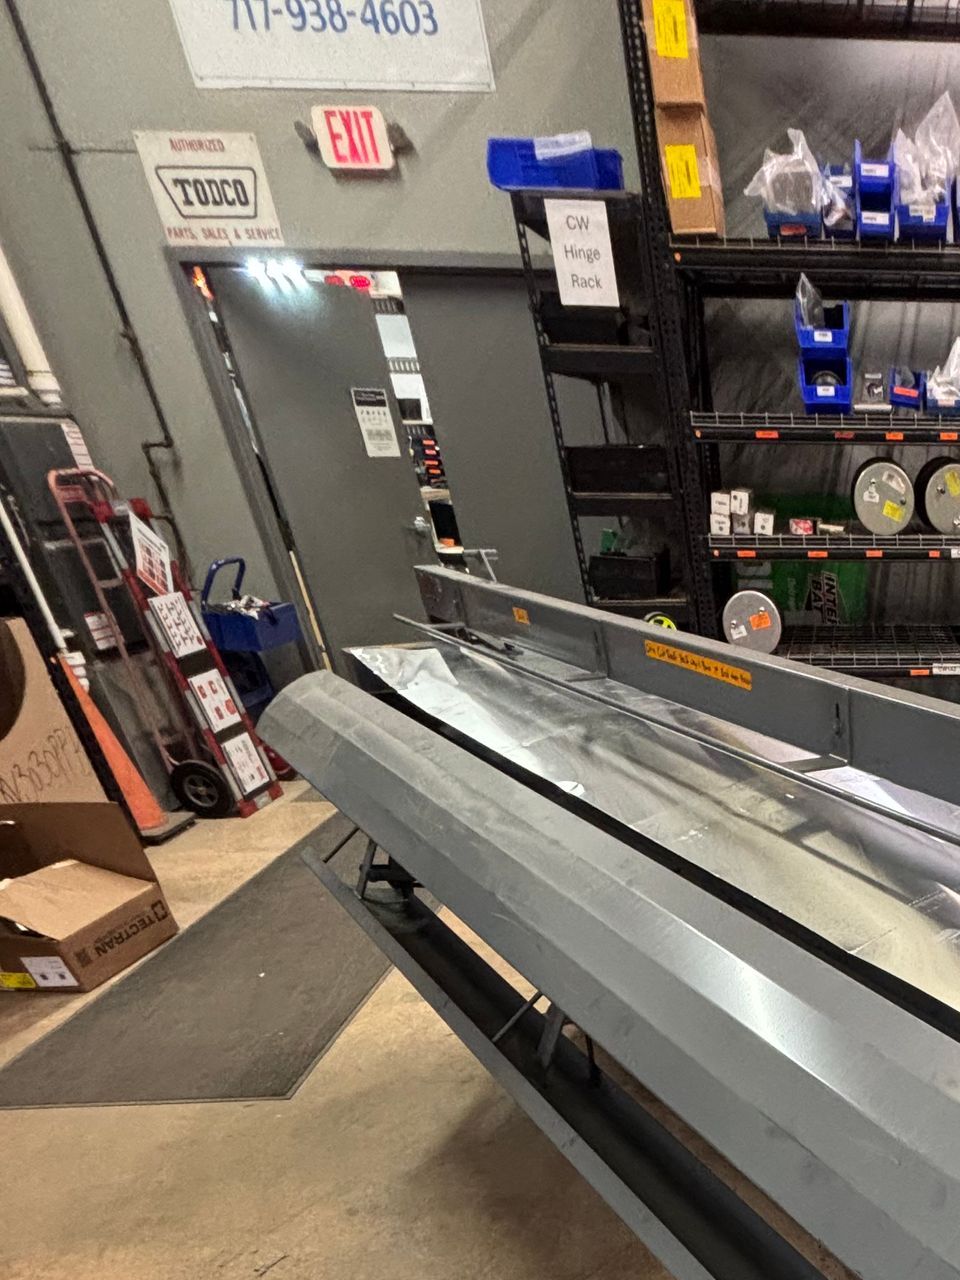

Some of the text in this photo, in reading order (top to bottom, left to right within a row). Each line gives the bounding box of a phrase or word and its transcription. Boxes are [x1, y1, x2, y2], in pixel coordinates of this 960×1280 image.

[168, 137, 225, 153] AUTHORIZED
[323, 109, 381, 164] EXIT
[174, 177, 250, 207] TODCO
[566, 214, 590, 230] CW
[202, 226, 229, 240] SALES
[245, 226, 281, 240] SERVICE
[564, 245, 601, 263] Hinge
[571, 273, 602, 289] Rack
[93, 913, 157, 957] TECTRAN
